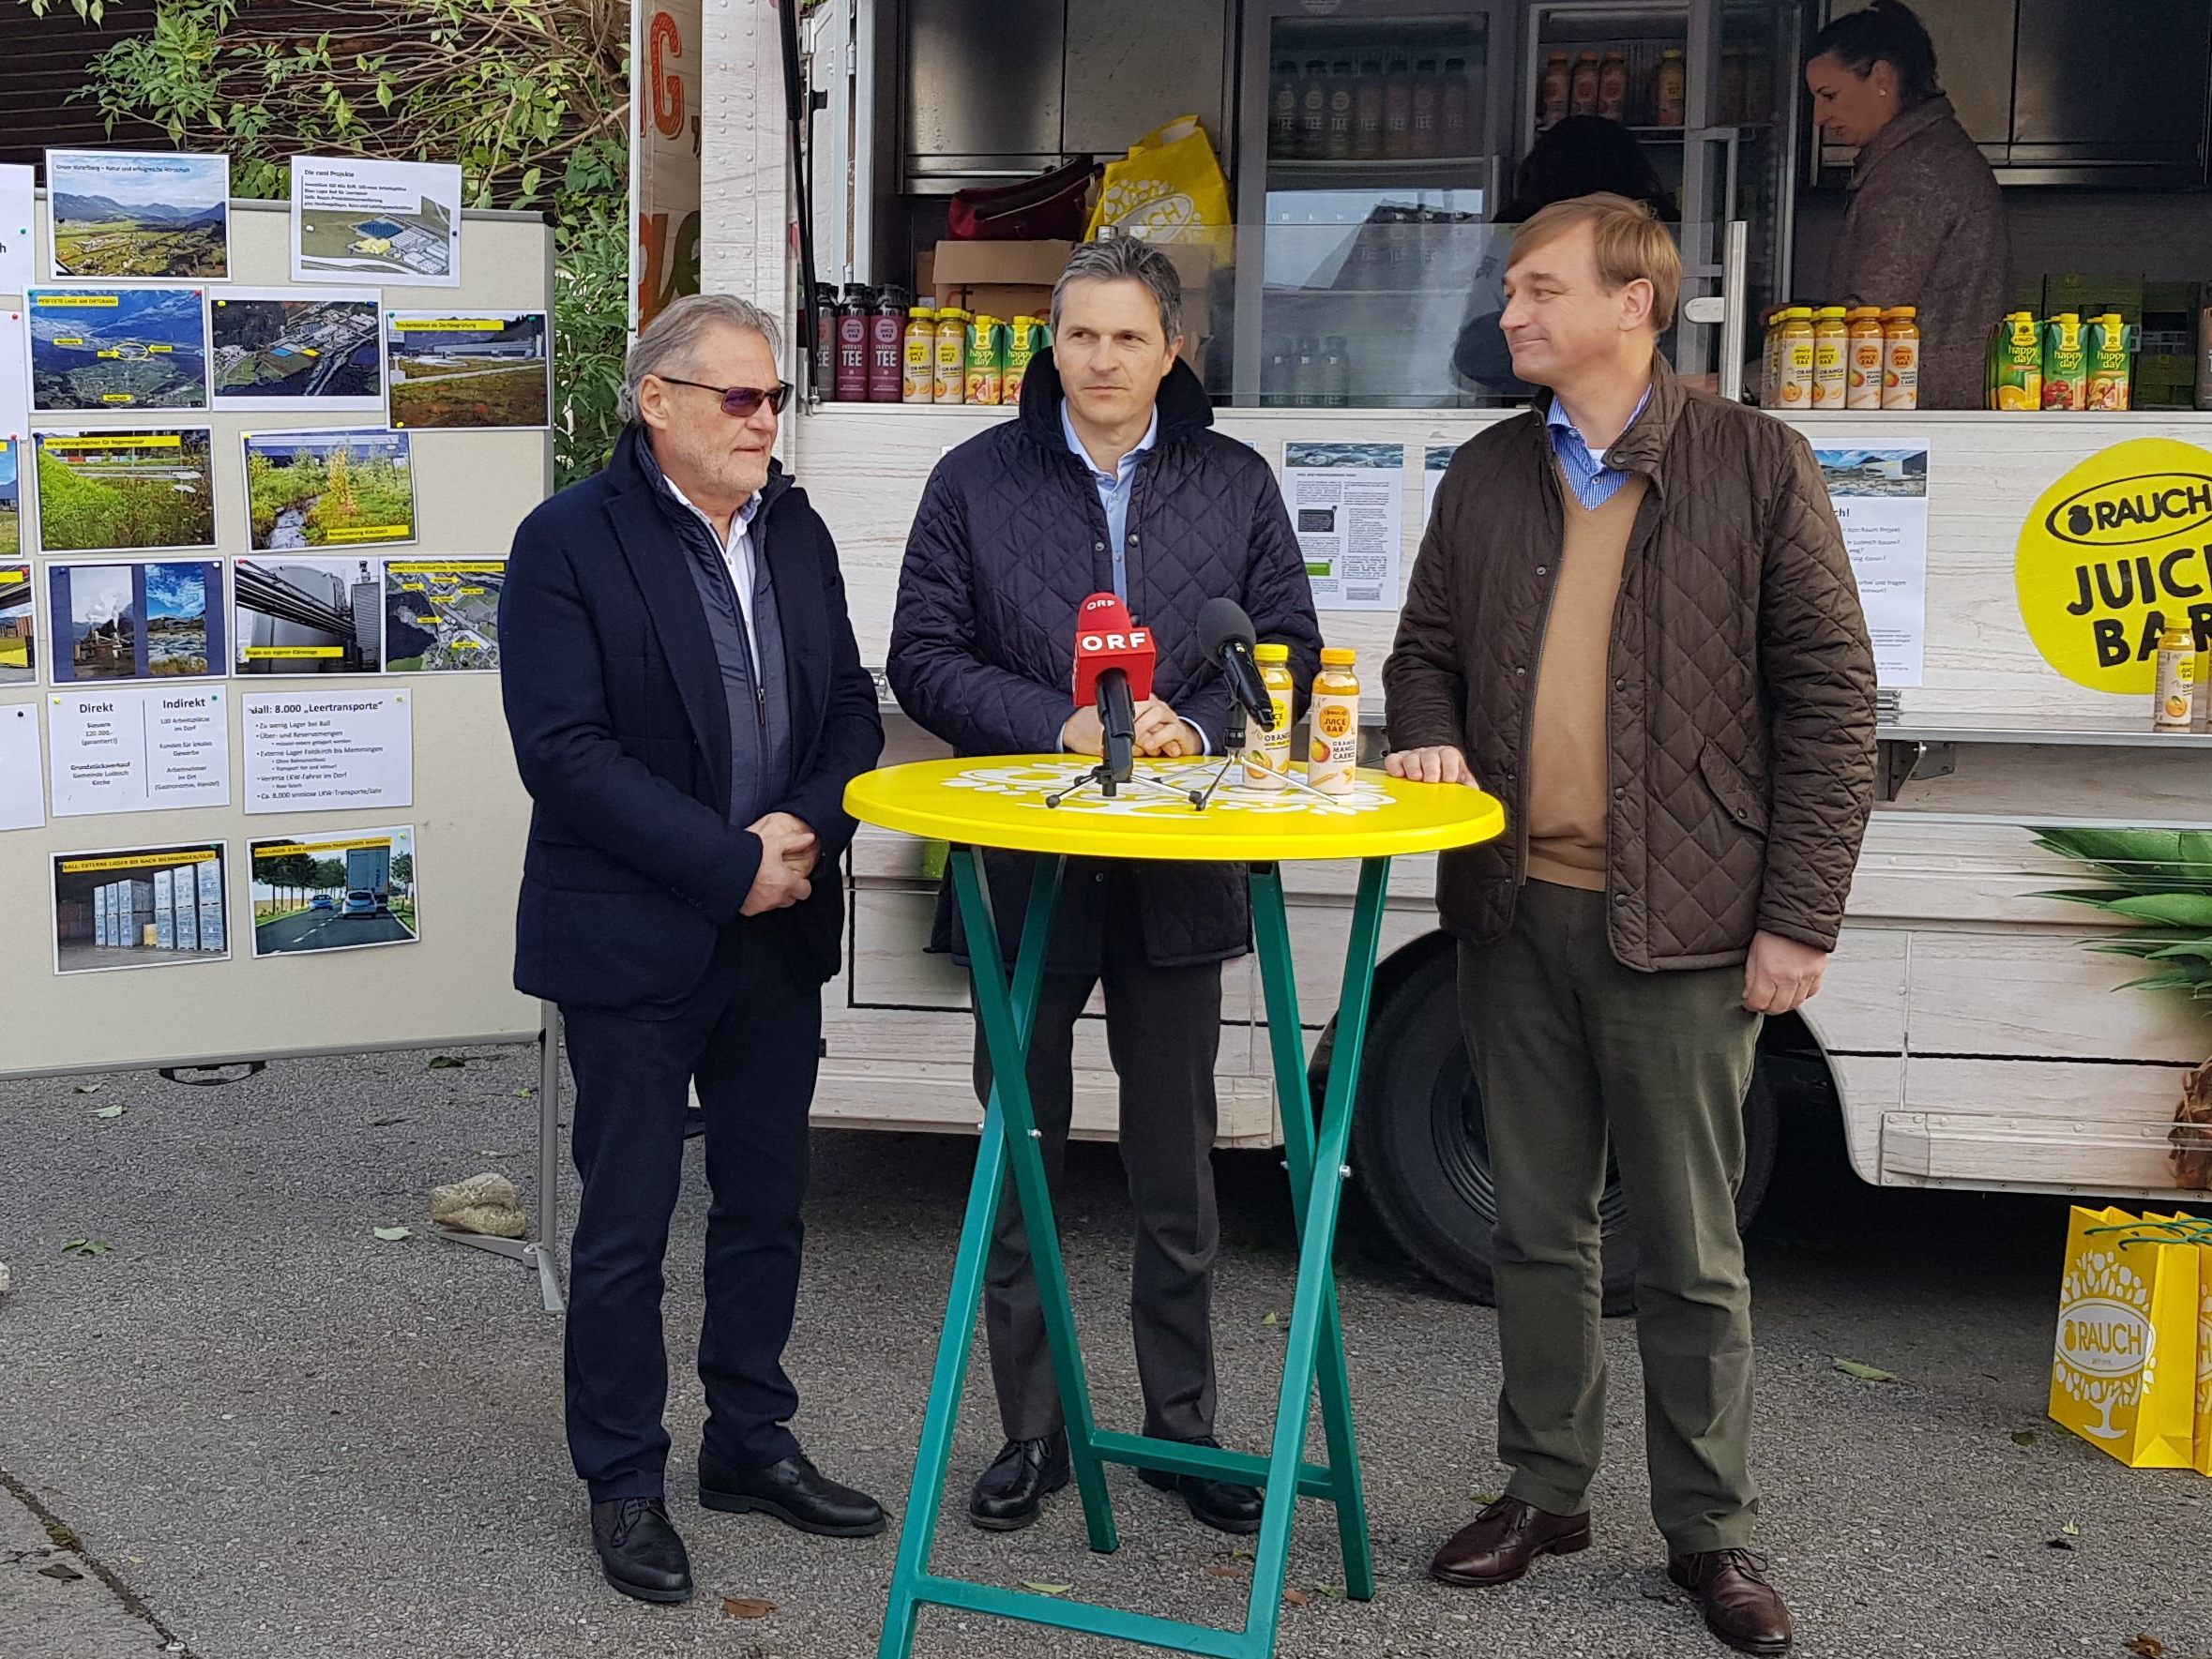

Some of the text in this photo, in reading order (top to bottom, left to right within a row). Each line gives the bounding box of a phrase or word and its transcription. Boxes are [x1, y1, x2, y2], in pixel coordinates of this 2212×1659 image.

[970, 348, 994, 359] happy
[2008, 345, 2038, 358] happy
[2054, 351, 2083, 364] happy
[2098, 351, 2126, 364] happy
[842, 351, 862, 366] TEE
[876, 351, 897, 367] TEE
[2014, 354, 2035, 365] day
[2059, 359, 2079, 370] day
[2102, 359, 2121, 370] day
[2095, 483, 2212, 531] RAUCH
[2067, 543, 2212, 616] JUIC
[1087, 599, 1114, 611] ORF
[1082, 632, 1145, 651] ORF
[80, 702, 114, 714] Direkt
[163, 698, 205, 709] Indirekt
[275, 704, 301, 714] 8.000
[1265, 731, 1291, 742] ORANG
[2077, 1320, 2143, 1356] RAUCH
